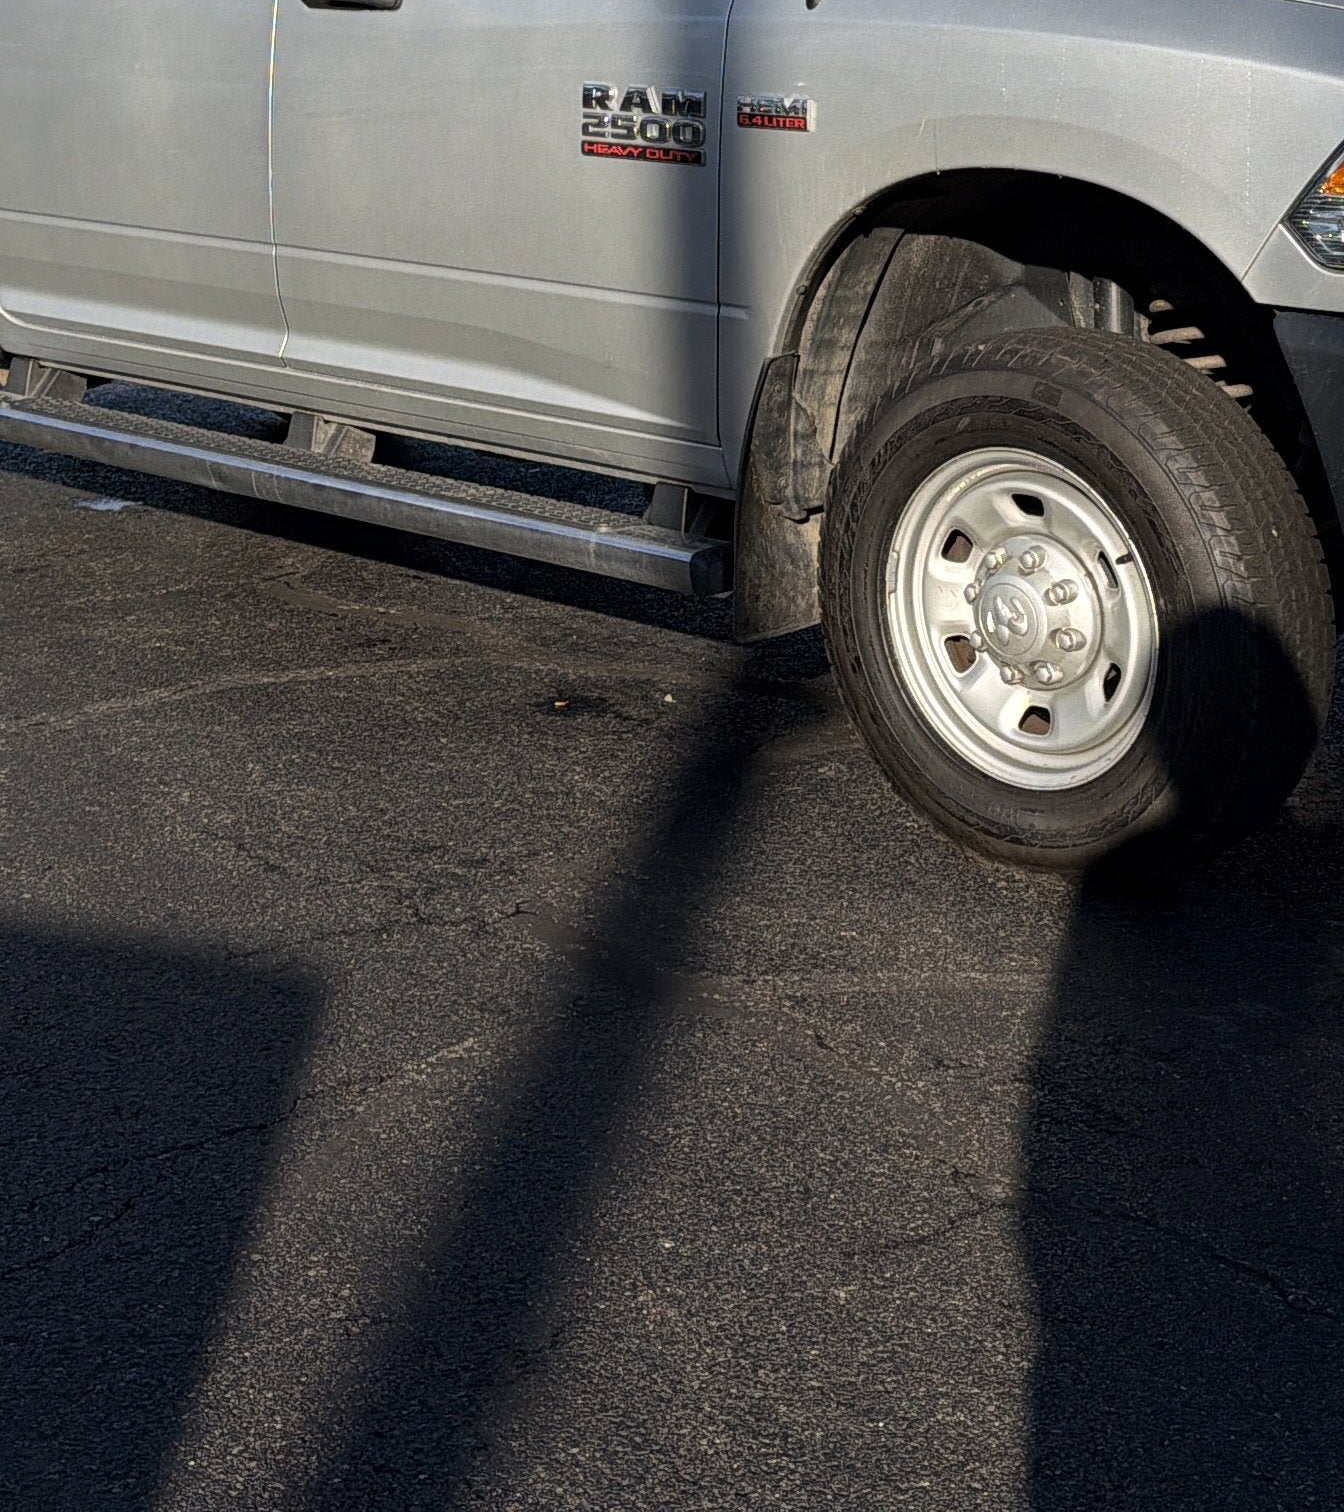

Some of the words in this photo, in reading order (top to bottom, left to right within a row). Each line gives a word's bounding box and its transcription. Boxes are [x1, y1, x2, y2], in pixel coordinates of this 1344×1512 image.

[582, 81, 707, 118] RAM
[581, 112, 706, 147] 2500
[764, 116, 805, 129] LITER
[584, 143, 643, 157] HEAVY
[646, 148, 696, 162] DUTY
